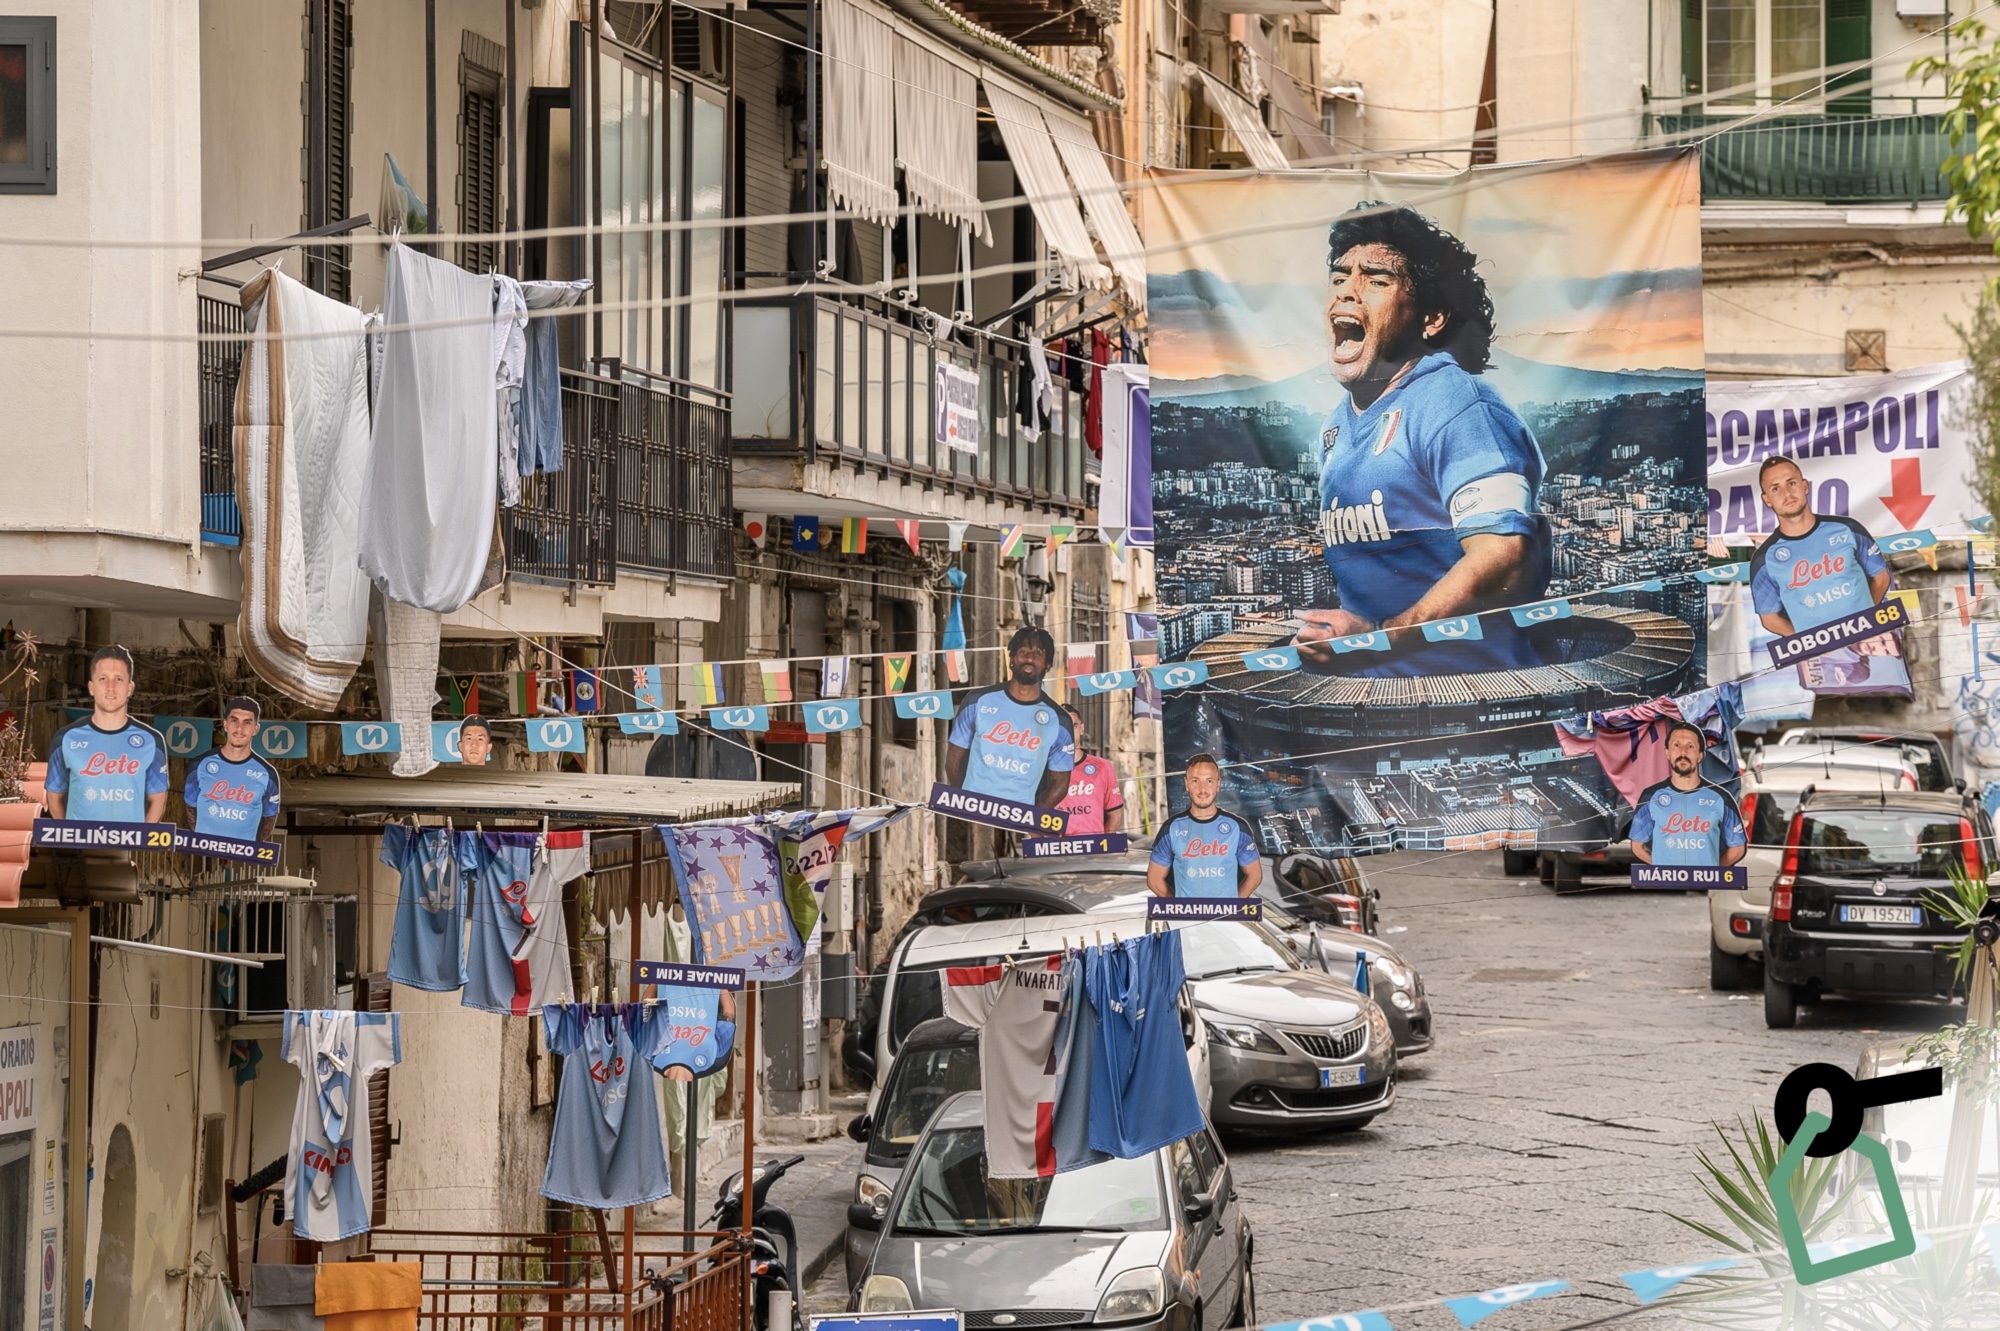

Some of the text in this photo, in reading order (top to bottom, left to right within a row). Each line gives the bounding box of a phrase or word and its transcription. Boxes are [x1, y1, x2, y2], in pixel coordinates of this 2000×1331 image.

[1828, 534, 1849, 547] EA7
[1788, 553, 1845, 589] Lete
[1815, 582, 1852, 606] MSC
[1773, 604, 1901, 660] LOBOTKA 68
[980, 705, 999, 715] EA7
[982, 721, 1042, 751] Lete
[70, 741, 89, 749] EA7
[79, 752, 140, 776] Lete
[996, 758, 1030, 774] MSC
[246, 769, 263, 779] EA7
[100, 788, 134, 801] MSC
[205, 780, 255, 804] Lete
[1067, 781, 1095, 797] ete
[1698, 798, 1716, 806] EA7
[218, 807, 248, 821] MSC
[936, 791, 1063, 831] ANGUISSA 99
[1066, 805, 1092, 816] MSC
[1661, 812, 1712, 834] Lete
[41, 826, 171, 847] ZIELIŃSKI 20
[1175, 829, 1188, 837] EA7
[174, 835, 274, 860] DI LORENZO 22
[1034, 839, 1108, 856] MERET 1
[1182, 838, 1229, 859] Lete
[1676, 837, 1706, 849] MSC
[1199, 867, 1226, 877] MSC
[1638, 867, 1734, 882] MÁRIO RUI 6
[1152, 903, 1257, 915] A.RRAHMANI 13
[1850, 906, 1912, 922] DV 195ZH
[639, 966, 740, 985] MINJAE KIM 3
[669, 1006, 697, 1018] MSC
[0, 1038, 35, 1069] ORARIO
